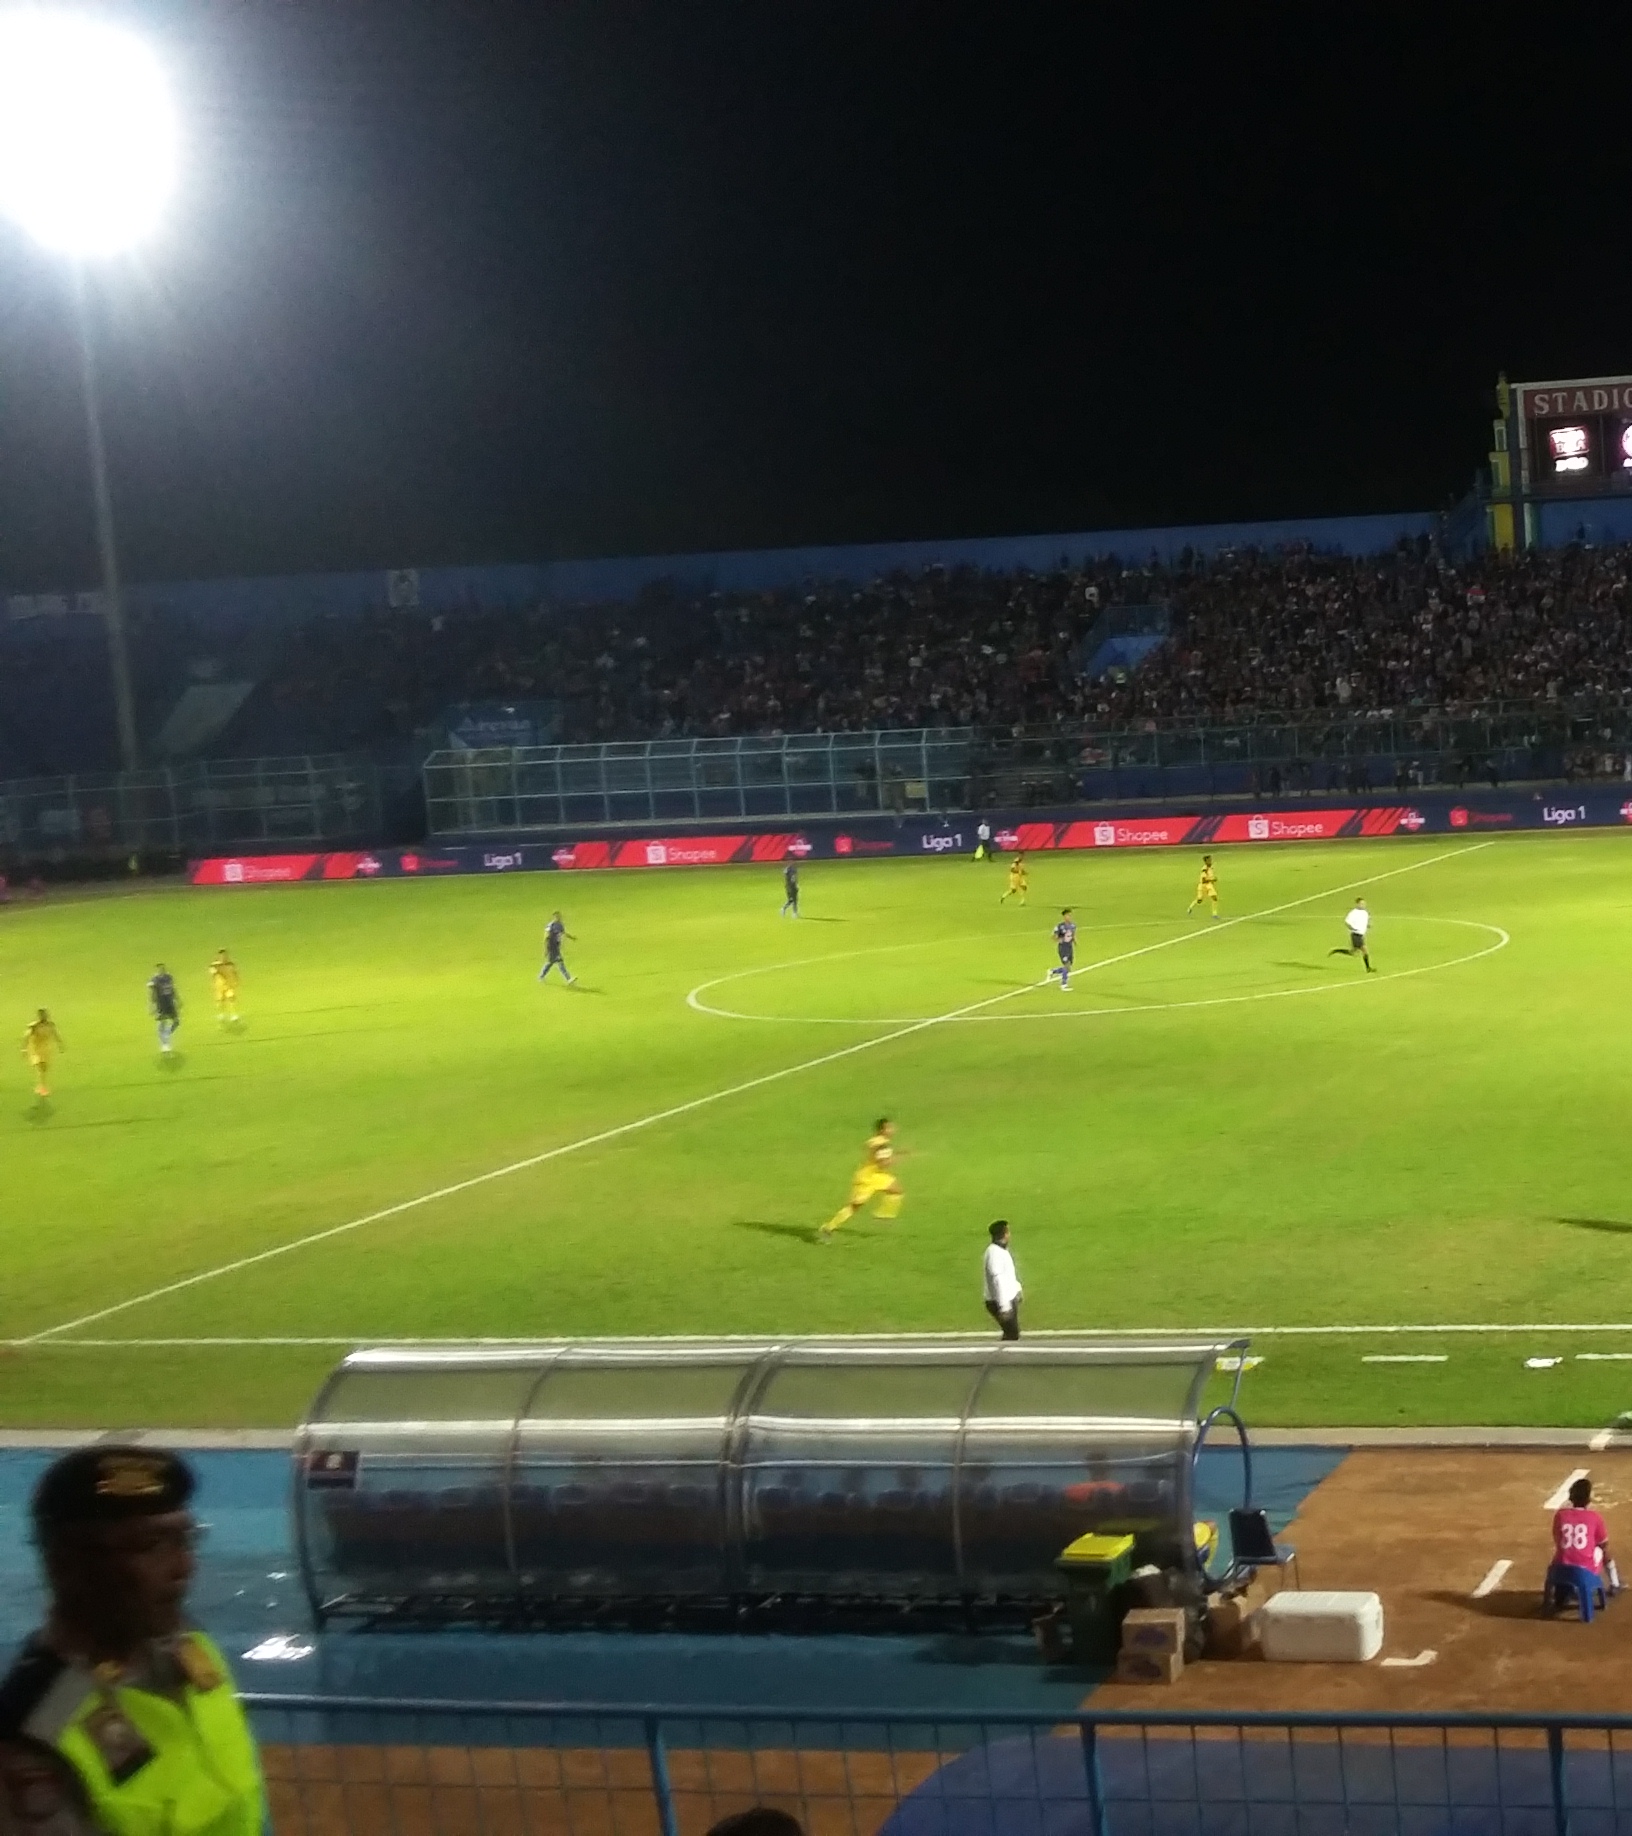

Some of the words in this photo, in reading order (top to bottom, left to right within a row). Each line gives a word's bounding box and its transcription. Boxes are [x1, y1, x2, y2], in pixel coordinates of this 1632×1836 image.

[1543, 807, 1576, 825] Liga
[1577, 805, 1586, 820] 1
[1117, 827, 1169, 845] Shopee
[1271, 819, 1325, 837] Shopee
[921, 833, 953, 852] Liga
[954, 833, 962, 848] 1
[1561, 1523, 1588, 1550] 38
